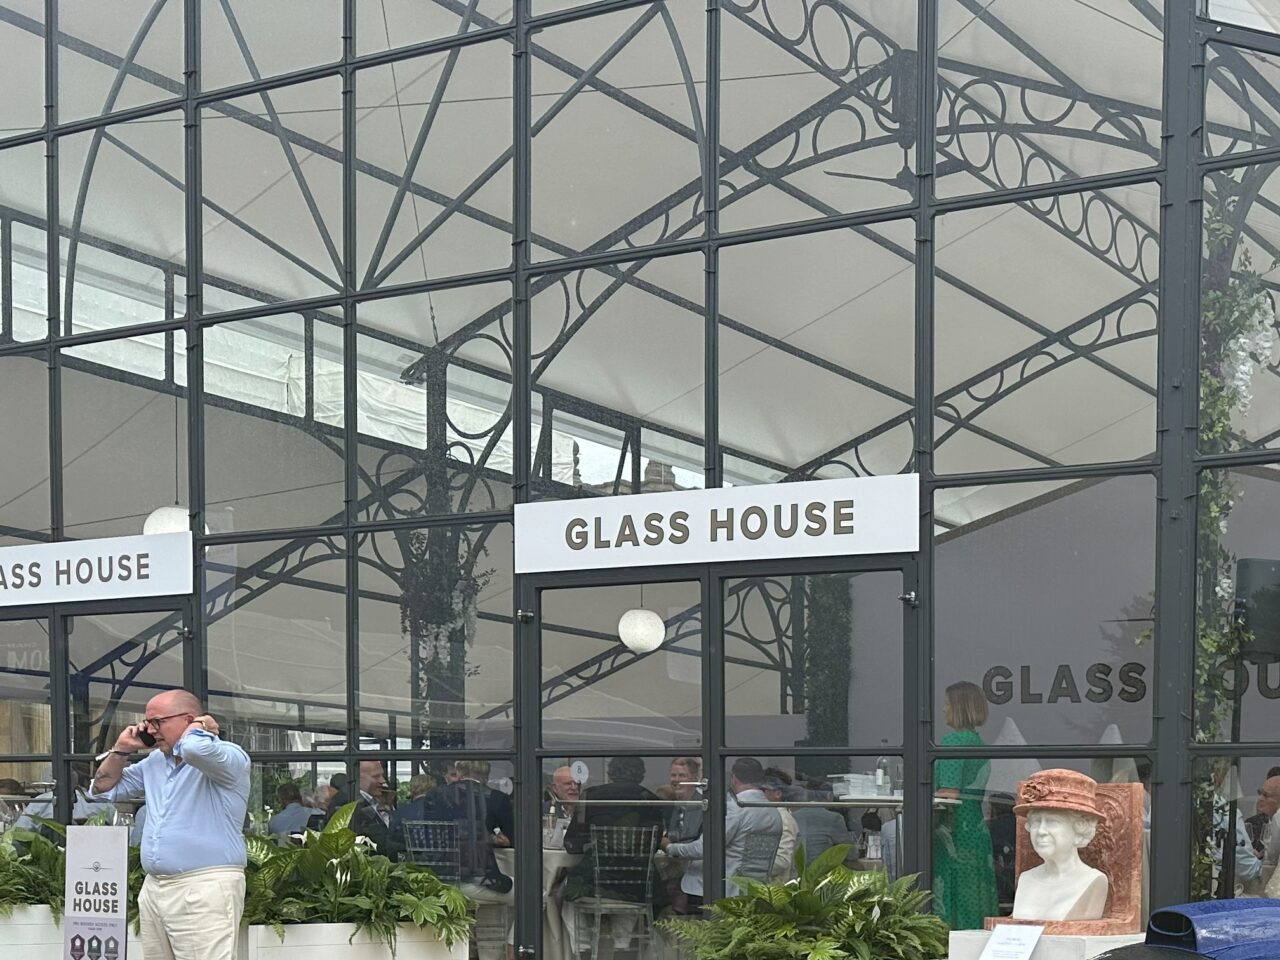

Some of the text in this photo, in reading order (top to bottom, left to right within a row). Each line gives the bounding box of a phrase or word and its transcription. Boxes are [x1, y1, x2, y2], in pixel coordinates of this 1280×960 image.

[564, 499, 855, 551] GLASS HOUSE
[0, 552, 150, 590] ASS HOUSE
[982, 662, 1147, 705] GLASS
[73, 898, 119, 913] HOUSE
[74, 881, 118, 896] GLASS
